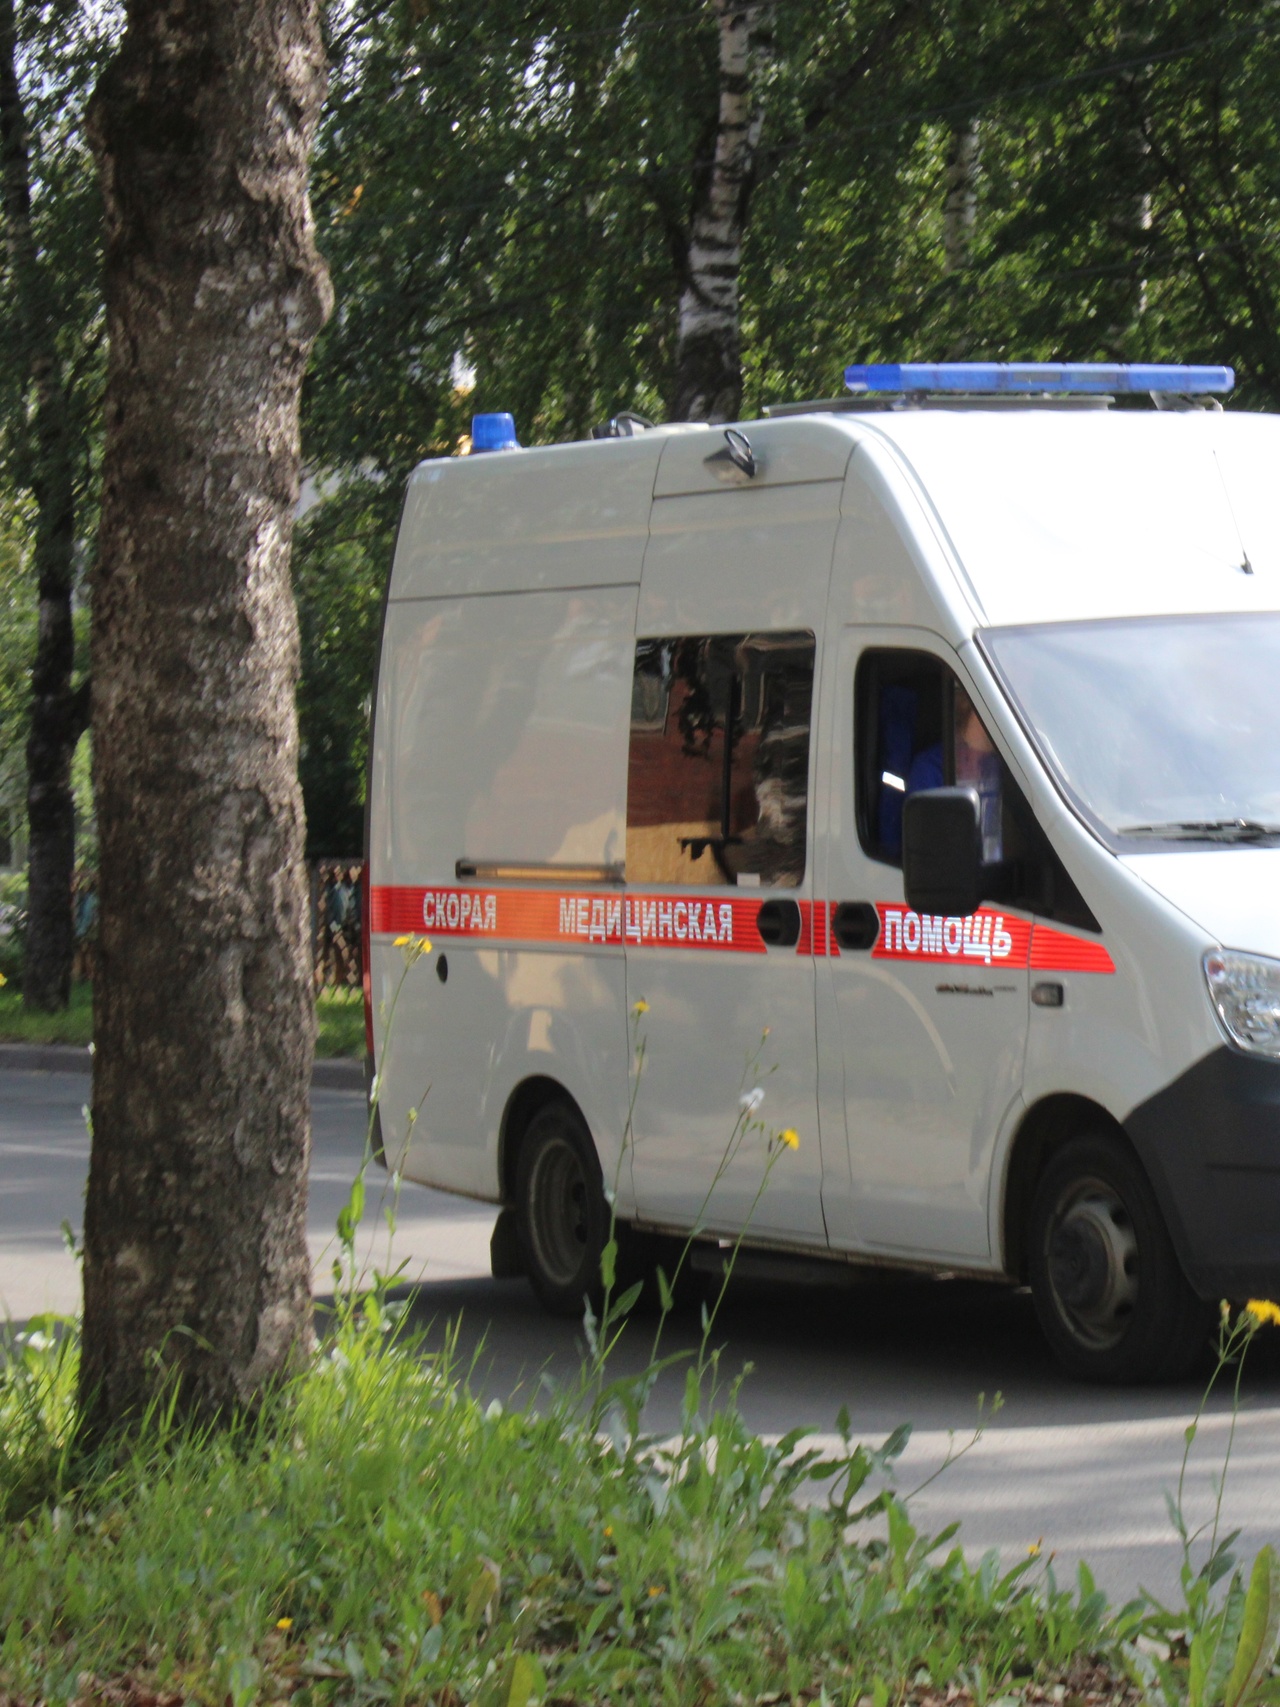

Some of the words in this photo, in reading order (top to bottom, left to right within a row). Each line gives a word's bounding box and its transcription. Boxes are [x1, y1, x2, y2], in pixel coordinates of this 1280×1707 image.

[423, 892, 497, 929] СКОРАЯ
[559, 898, 733, 943] МЕДИЦИНСКАЯ
[885, 910, 1012, 965] ПОМОЩЬ
